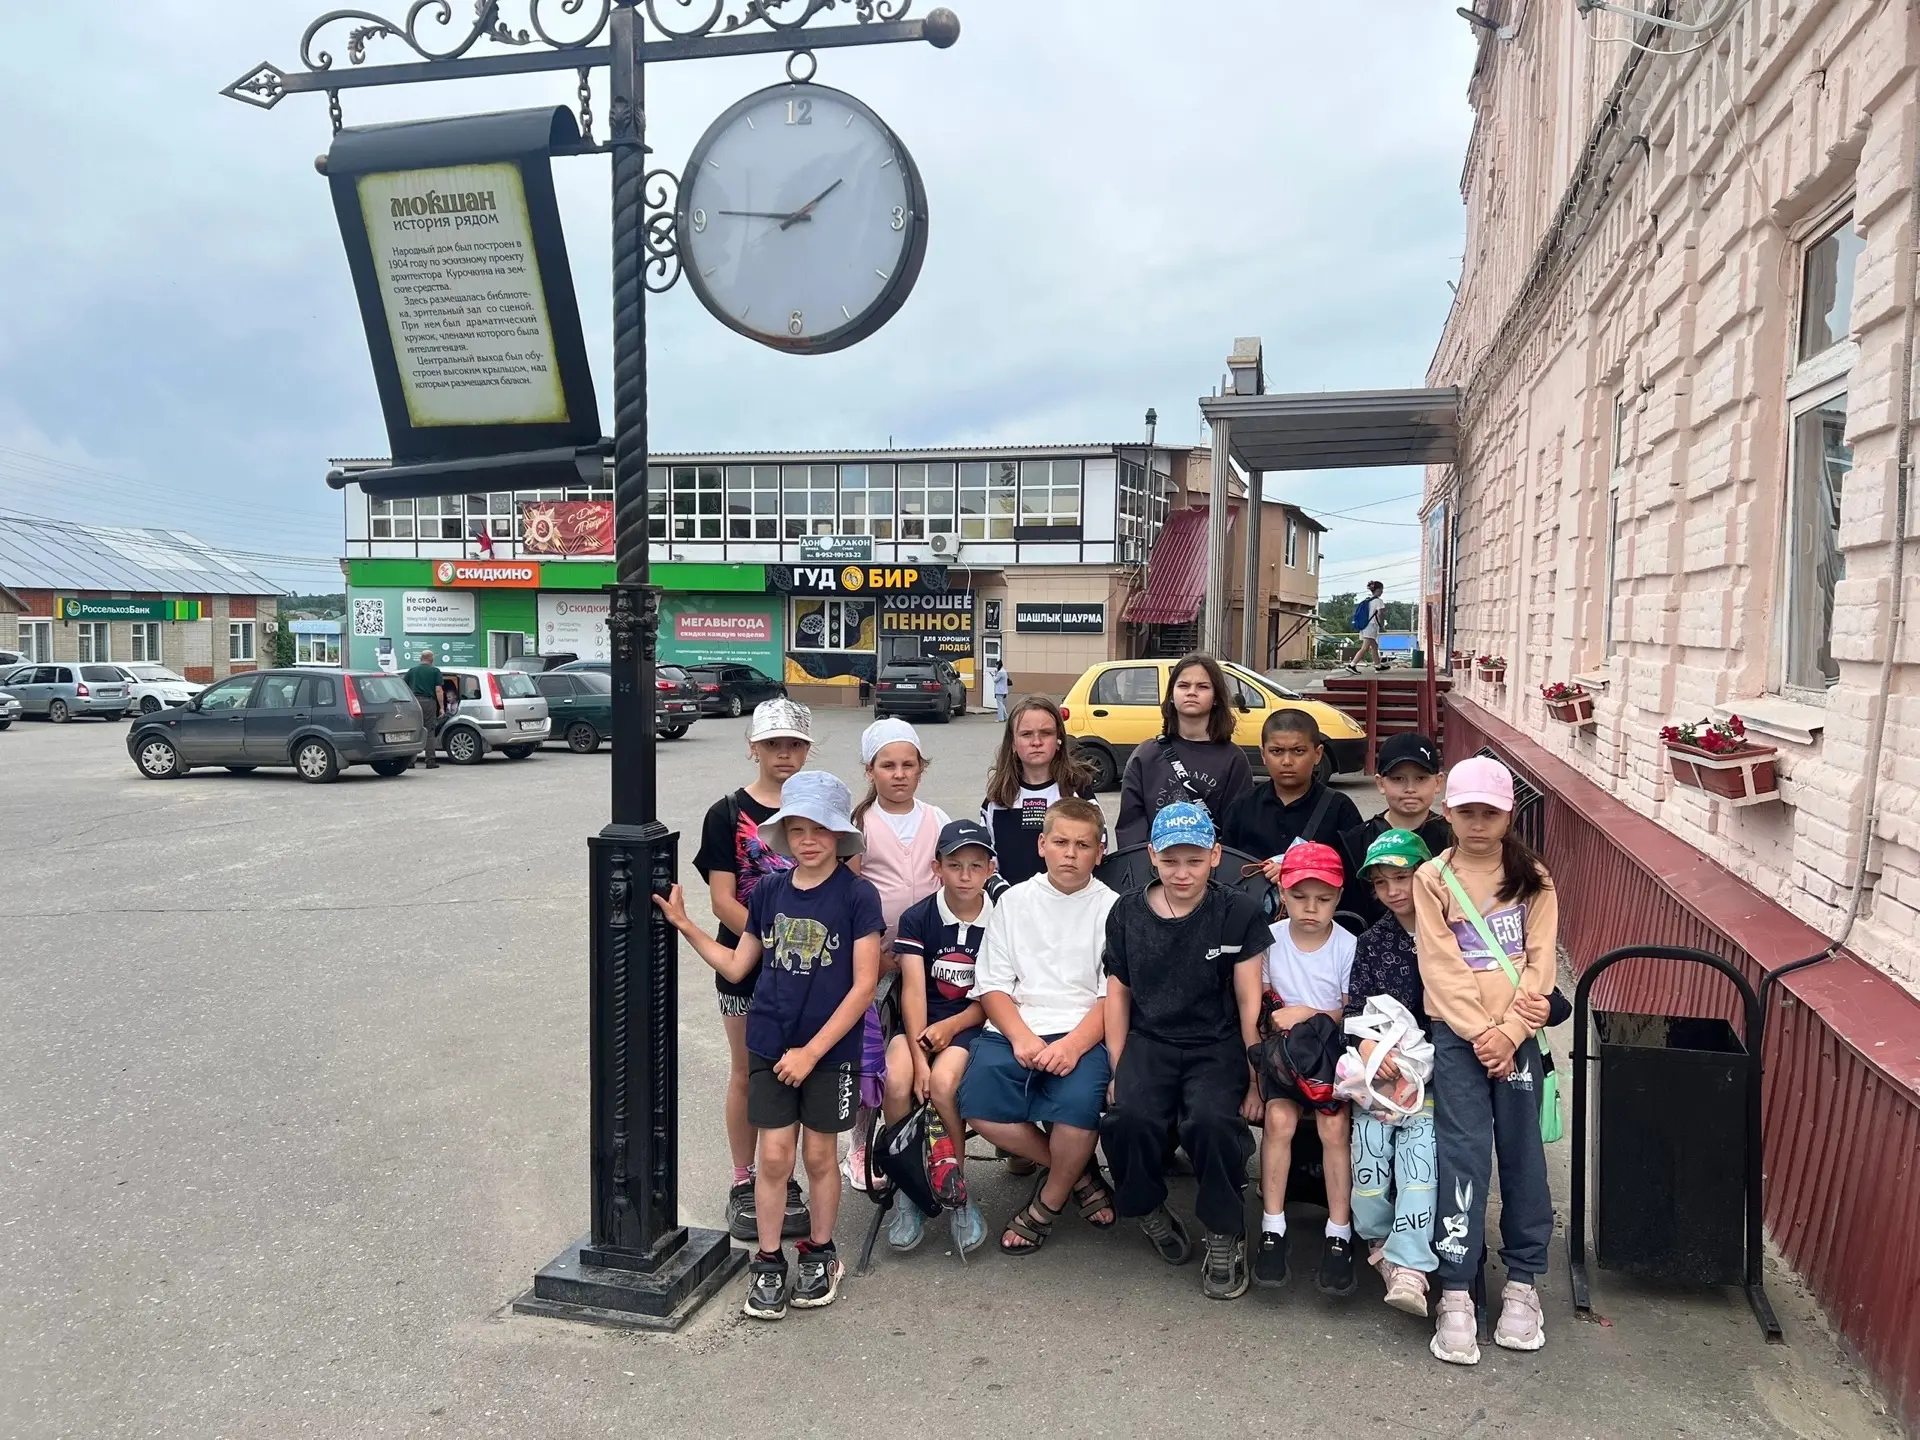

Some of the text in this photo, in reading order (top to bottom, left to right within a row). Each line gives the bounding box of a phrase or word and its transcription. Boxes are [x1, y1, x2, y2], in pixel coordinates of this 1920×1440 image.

[784, 99, 812, 125] 12
[393, 213, 499, 232] история рядом
[693, 208, 708, 233] 9
[890, 205, 905, 231] 3
[392, 245, 435, 257] Народный
[436, 244, 453, 254] дом
[455, 241, 472, 252] был
[474, 240, 513, 251] построен
[388, 252, 524, 270] 1904 году по эскизному проекту
[390, 266, 526, 282] архитектора Курочкина на зем-
[393, 282, 451, 293] ские средства.
[404, 290, 531, 306] Здесь размещалась библиоте-
[399, 310, 411, 318] ка,
[413, 305, 465, 318] зрительный
[466, 305, 482, 314] зал
[401, 314, 537, 331] При нем был драматический
[787, 310, 803, 334] 6
[404, 326, 539, 343] кружок, членами которого была
[407, 343, 468, 354] интеллигенция.
[417, 351, 544, 366] Центральный выход был обу-
[412, 364, 547, 379] строен высоким крыльцом, над
[415, 376, 532, 389] которым размещался балкон.
[456, 567, 532, 581] СКИДКИНО
[793, 568, 919, 591] ГУД БИР
[417, 596, 437, 604] стой
[883, 594, 972, 609] ХОРОШЕЕ
[82, 604, 151, 614] РоссельхозБанк
[412, 605, 449, 613] очереди
[568, 605, 611, 613] СКИДКИН
[681, 617, 765, 630] МЕГАВЫГОДА
[883, 612, 971, 631] ПЕННОЕ
[1017, 612, 1102, 624] ШАШЛЫК ШАУРМА
[707, 631, 736, 639] каждую
[938, 642, 971, 652] ЛЮДЕЙ
[1171, 760, 1189, 779] NIKE
[1166, 816, 1198, 828] HUGO
[1491, 910, 1522, 933] FRE
[838, 1061, 853, 1120] adidas
[1435, 1241, 1469, 1256] LOONEY
